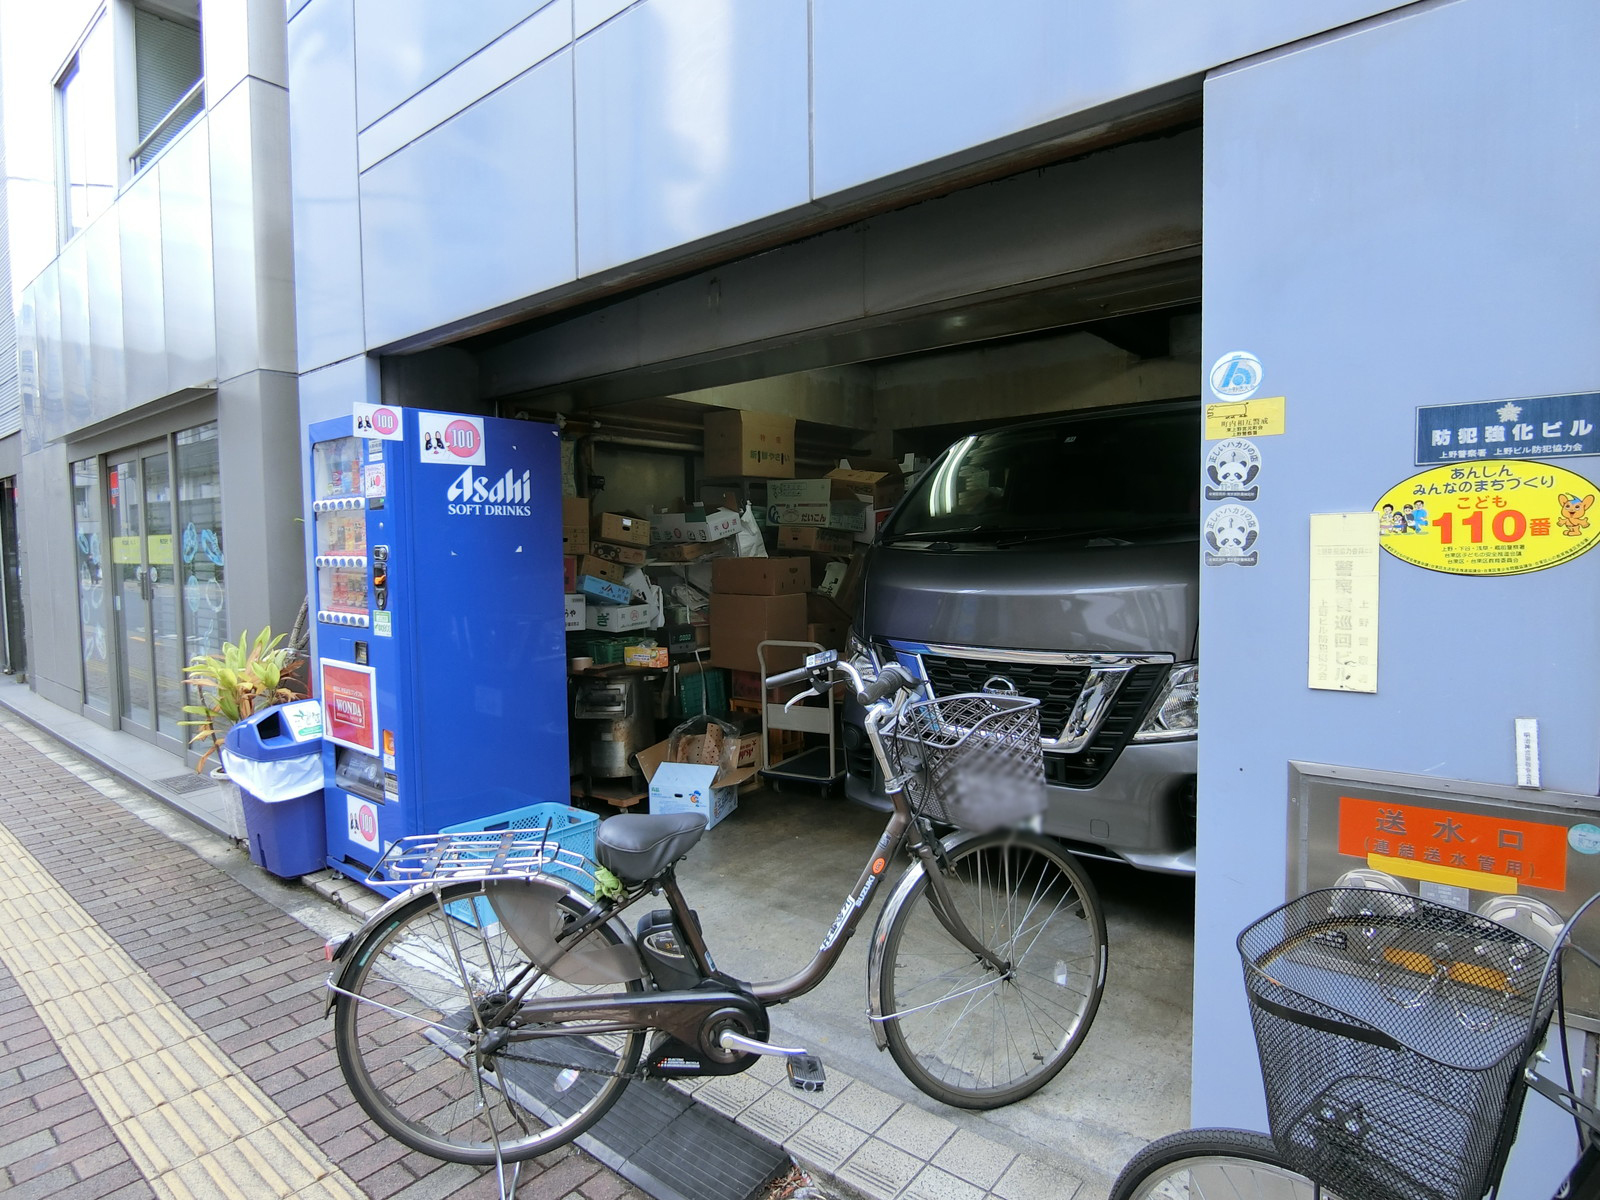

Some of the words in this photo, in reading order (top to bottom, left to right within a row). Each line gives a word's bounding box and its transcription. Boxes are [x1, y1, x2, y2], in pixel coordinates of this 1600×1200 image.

[377, 414, 394, 429] 100
[450, 428, 474, 450] 100
[1431, 419, 1593, 447] 防犯強化ビル
[1208, 441, 1259, 464] 正しいハカリの店
[1439, 448, 1488, 460] 上野警察署
[1493, 444, 1583, 456] 上野ビル防犯協力会
[1450, 465, 1514, 480] あんしん
[447, 466, 531, 505] Asahi
[1413, 475, 1555, 496] みんなのまちづくり
[448, 504, 482, 516] SOFT
[484, 504, 532, 517] DRINKS
[1457, 496, 1508, 510] こども
[1206, 507, 1257, 529] 正しいハカリの店
[1432, 509, 1551, 545] 110番
[336, 698, 363, 718] WONDA
[361, 813, 373, 834] 100
[1375, 807, 1525, 851] 送水口
[855, 874, 876, 908] SUZUKI
